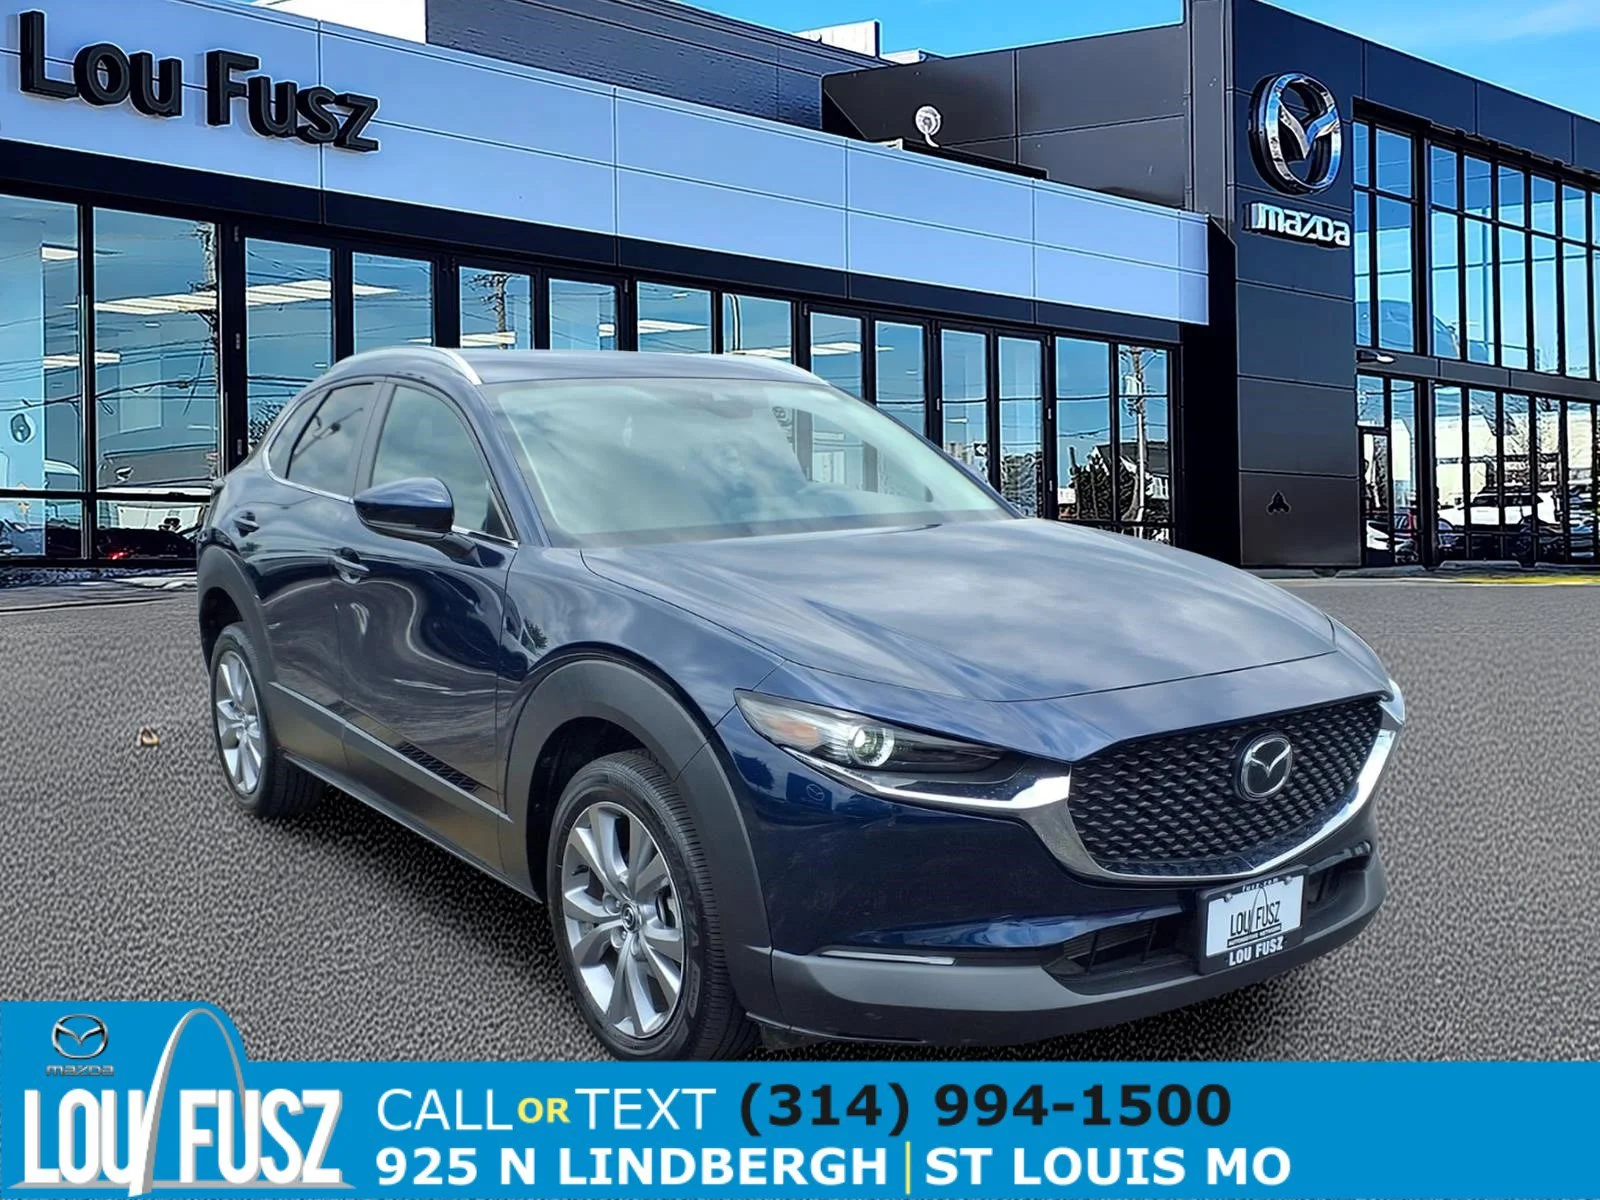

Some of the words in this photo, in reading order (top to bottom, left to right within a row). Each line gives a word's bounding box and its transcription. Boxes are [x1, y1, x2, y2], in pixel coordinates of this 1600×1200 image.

[20, 10, 182, 117] Lou
[206, 50, 379, 152] Fusz
[1230, 909, 1252, 936] LOU
[1255, 901, 1281, 929] FUSZ
[1229, 946, 1252, 966] LOU
[1255, 936, 1284, 958] FUSZ
